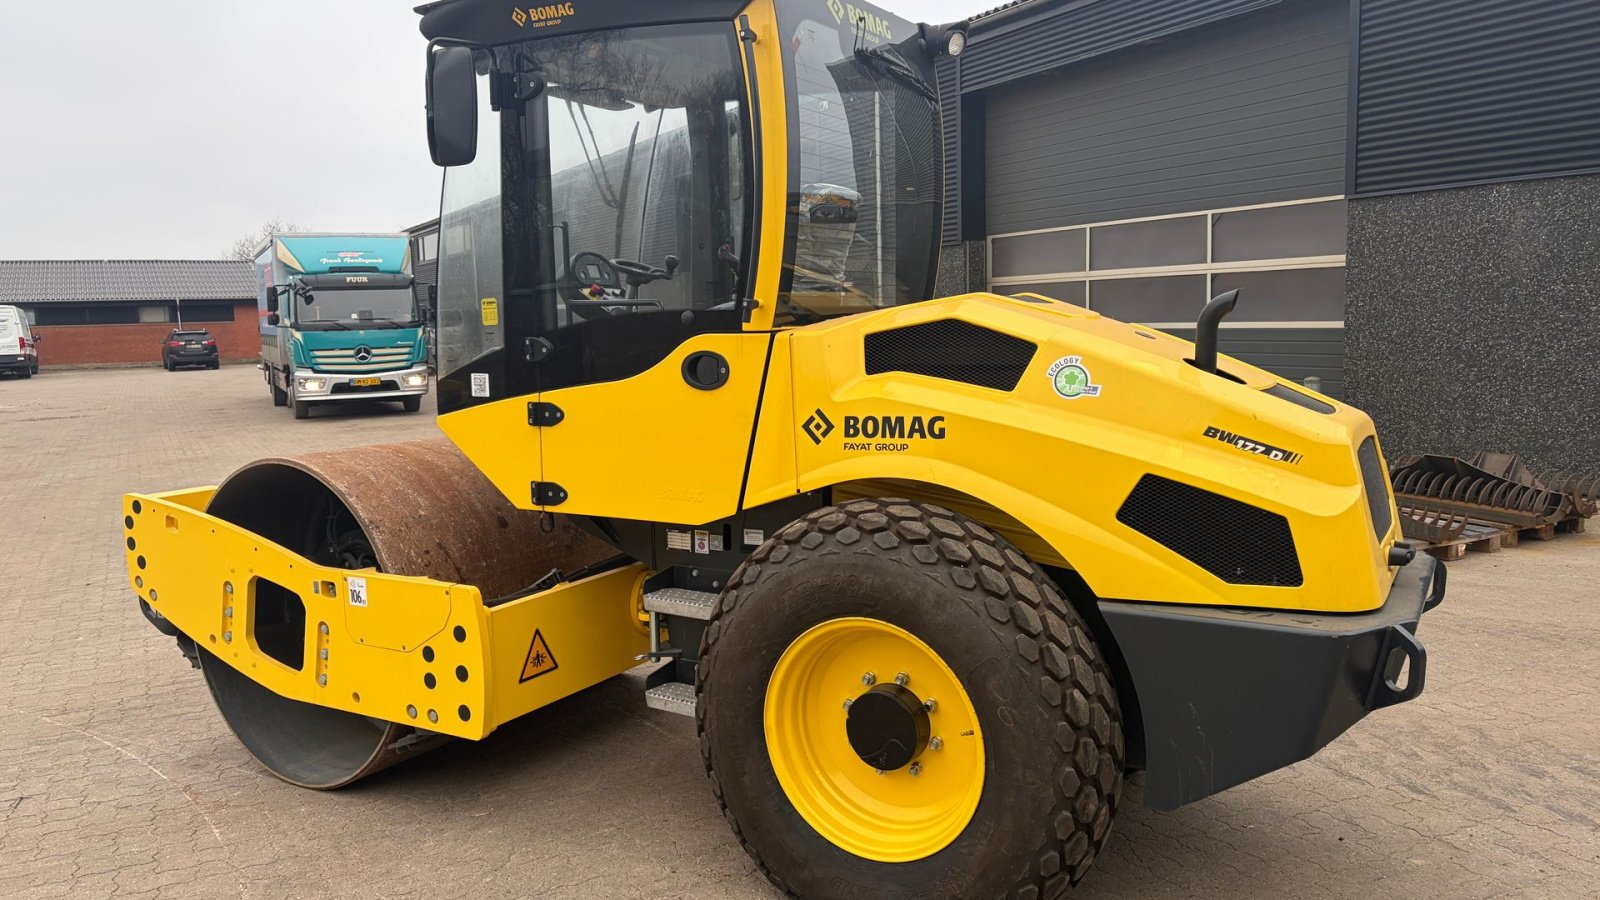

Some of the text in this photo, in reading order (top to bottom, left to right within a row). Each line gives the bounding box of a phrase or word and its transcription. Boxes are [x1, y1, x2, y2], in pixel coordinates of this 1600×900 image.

[528, 2, 575, 21] BOMAG
[846, 3, 892, 40] BOMAG
[1048, 358, 1080, 377] ECOLOGY
[843, 415, 946, 439] BOMAG
[843, 442, 909, 452] FAYAT GROUP
[350, 588, 362, 604] 106
